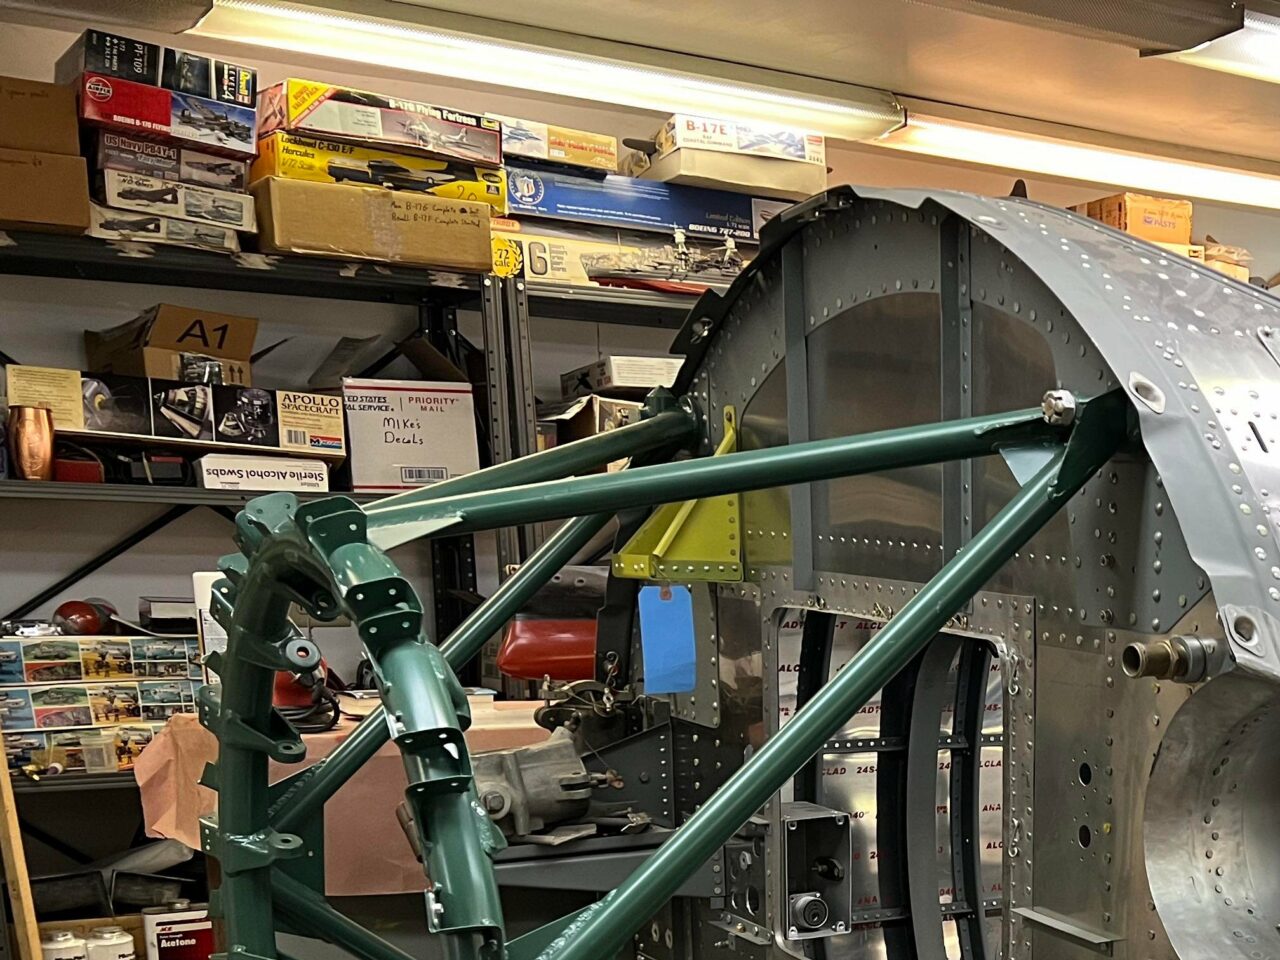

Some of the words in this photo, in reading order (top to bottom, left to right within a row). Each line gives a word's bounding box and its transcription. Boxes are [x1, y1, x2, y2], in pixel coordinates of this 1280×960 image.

[222, 90, 235, 100] 4
[113, 114, 135, 126] BOEING
[416, 104, 442, 120] Flying
[442, 110, 477, 126] Fortress
[686, 119, 728, 136] B-17E
[104, 133, 119, 147] US
[119, 136, 143, 153] Navy
[280, 134, 317, 150] Lockheed
[318, 140, 340, 154] C-130
[281, 146, 315, 159] Hercules
[688, 223, 718, 233] BOEING
[528, 241, 548, 275] 6
[175, 319, 230, 350] A1
[282, 393, 340, 408] APOLLO
[359, 395, 387, 403] STATES
[408, 396, 456, 405] PRIORITY
[281, 402, 340, 415] SPACECRAFT
[420, 405, 445, 413] MAIL
[206, 468, 244, 479] Swabs
[246, 469, 288, 480] Alcohol
[289, 471, 324, 482] Sterile
[855, 621, 883, 630] ALCL
[856, 765, 878, 774] 24S-
[160, 938, 197, 948] Acetone
